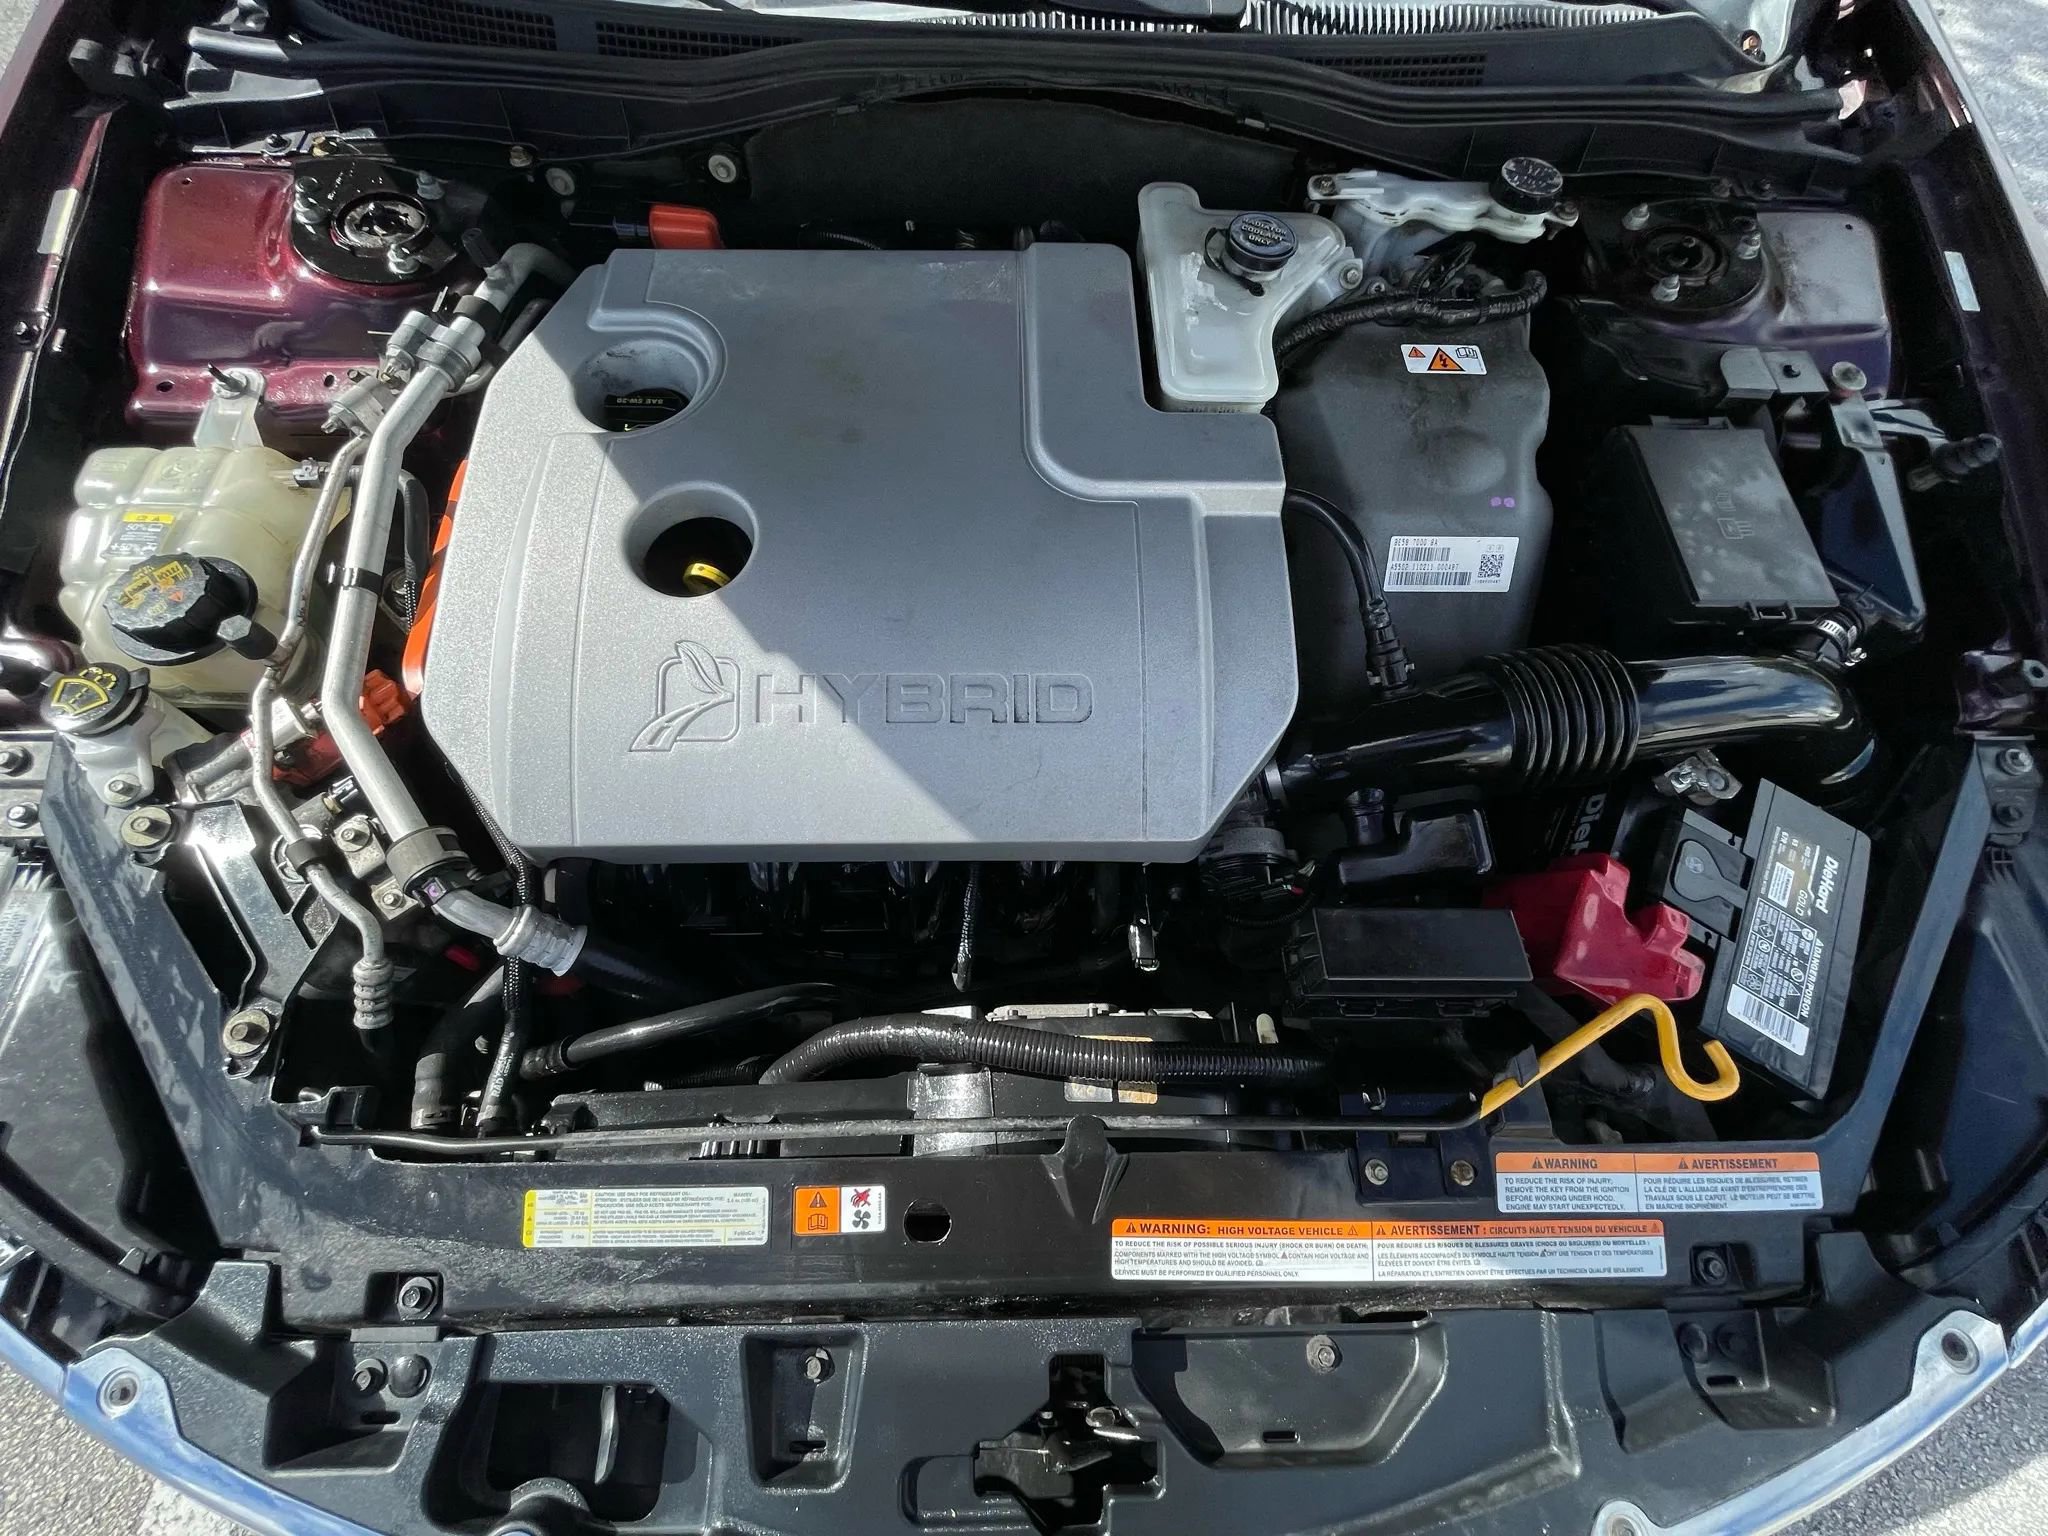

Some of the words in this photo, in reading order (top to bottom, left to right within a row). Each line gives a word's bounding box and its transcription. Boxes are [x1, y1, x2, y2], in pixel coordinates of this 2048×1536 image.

[1241, 225, 1284, 241] COOLANT
[1242, 217, 1287, 236] RADIATOR
[1248, 235, 1271, 245] ONLY
[755, 672, 1093, 724] HYBRID
[1816, 856, 1839, 914] DieHard
[1795, 890, 1807, 916] GOLD
[1801, 946, 1821, 1018] DANGER/POISON
[1544, 1158, 1598, 1169] WARNING
[1692, 1159, 1777, 1169] AVERTISSEMENT
[1664, 1176, 1692, 1184] RÉDUIRE
[1655, 1185, 1667, 1193] CLÉ
[1139, 1223, 1210, 1234] WARNING:
[1218, 1226, 1244, 1235] HIGH
[1248, 1227, 1295, 1235] VOLTAGE
[1299, 1227, 1343, 1236] VEHICLE
[1391, 1225, 1480, 1235] AVERTISSEMENT
[1529, 1226, 1556, 1234] HAUTE
[1558, 1225, 1592, 1233] TENSION
[1595, 1225, 1605, 1233] DU
